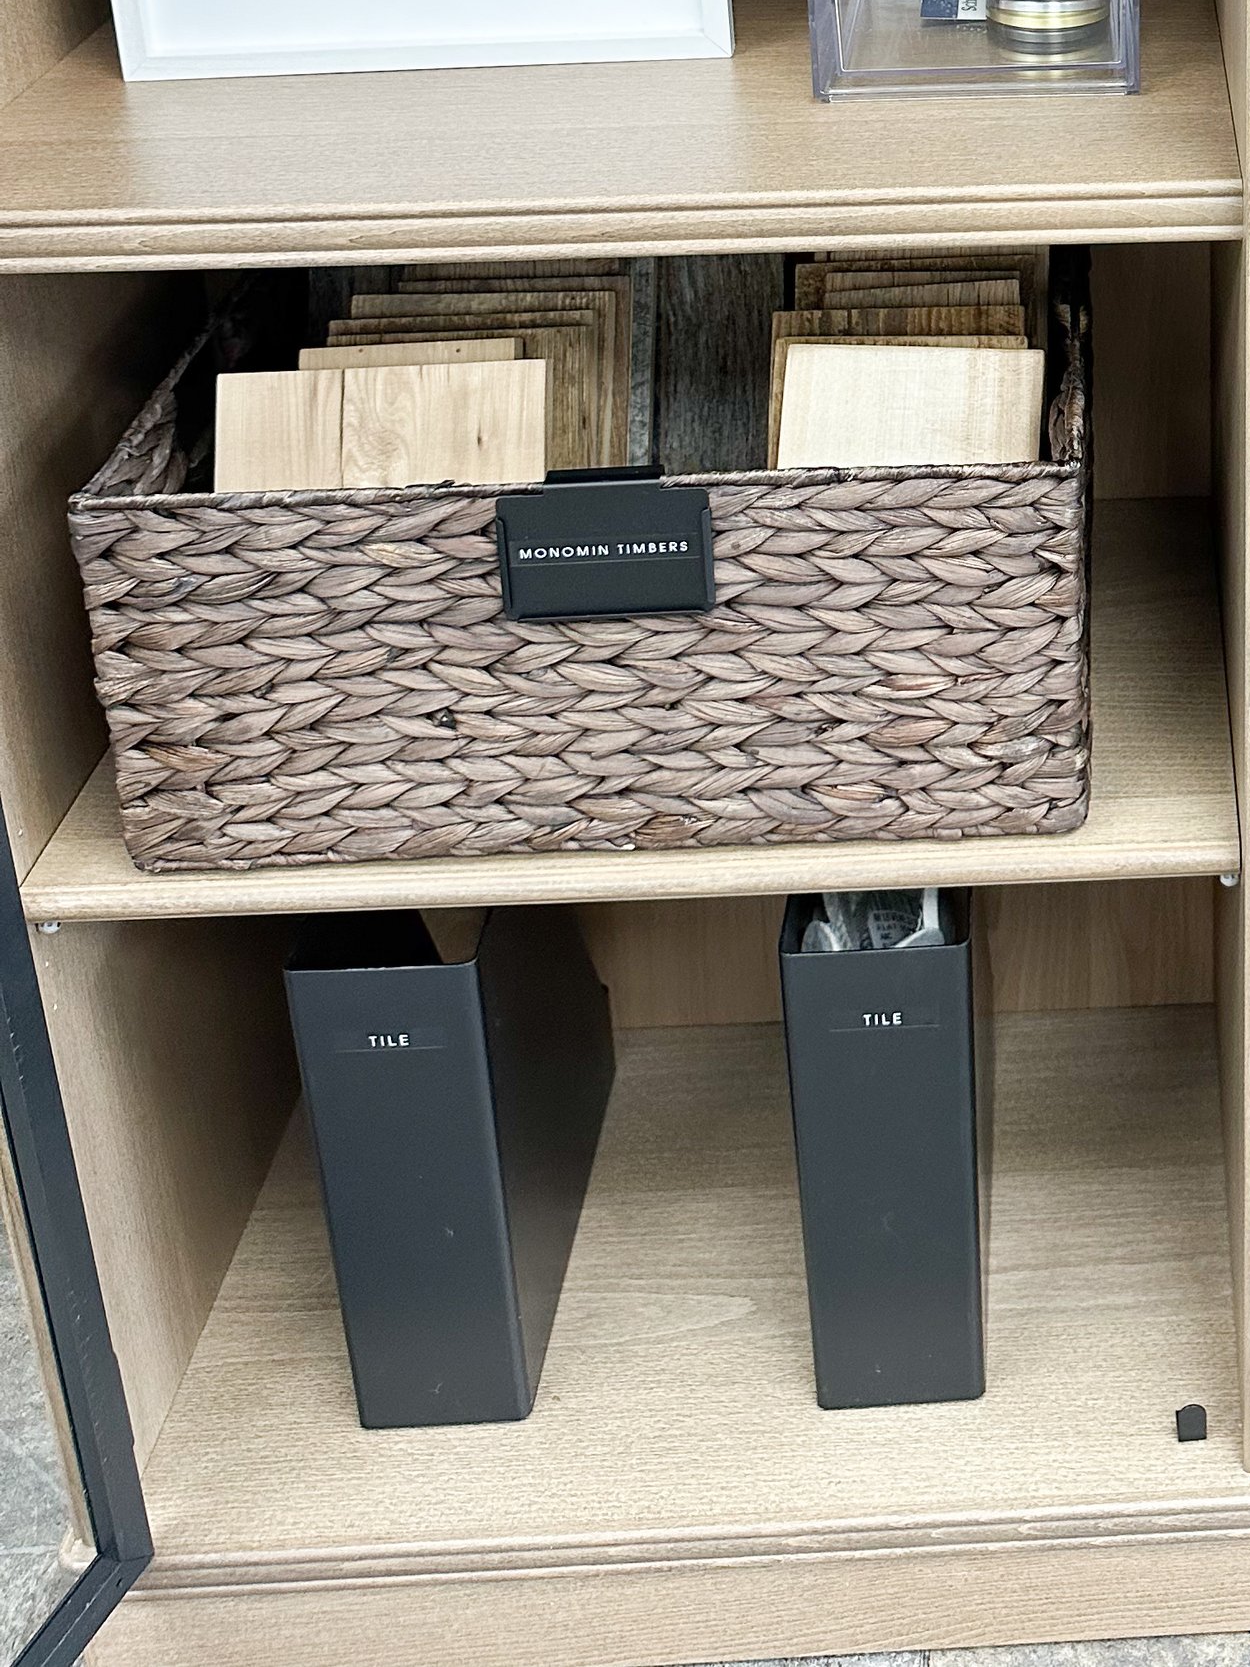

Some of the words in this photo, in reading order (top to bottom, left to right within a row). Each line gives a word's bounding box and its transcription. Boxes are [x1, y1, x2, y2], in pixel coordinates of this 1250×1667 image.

[518, 544, 610, 560] MONOMIN
[616, 540, 690, 555] TIMBERS
[862, 1012, 903, 1027] TILE
[368, 1034, 410, 1048] TILE
